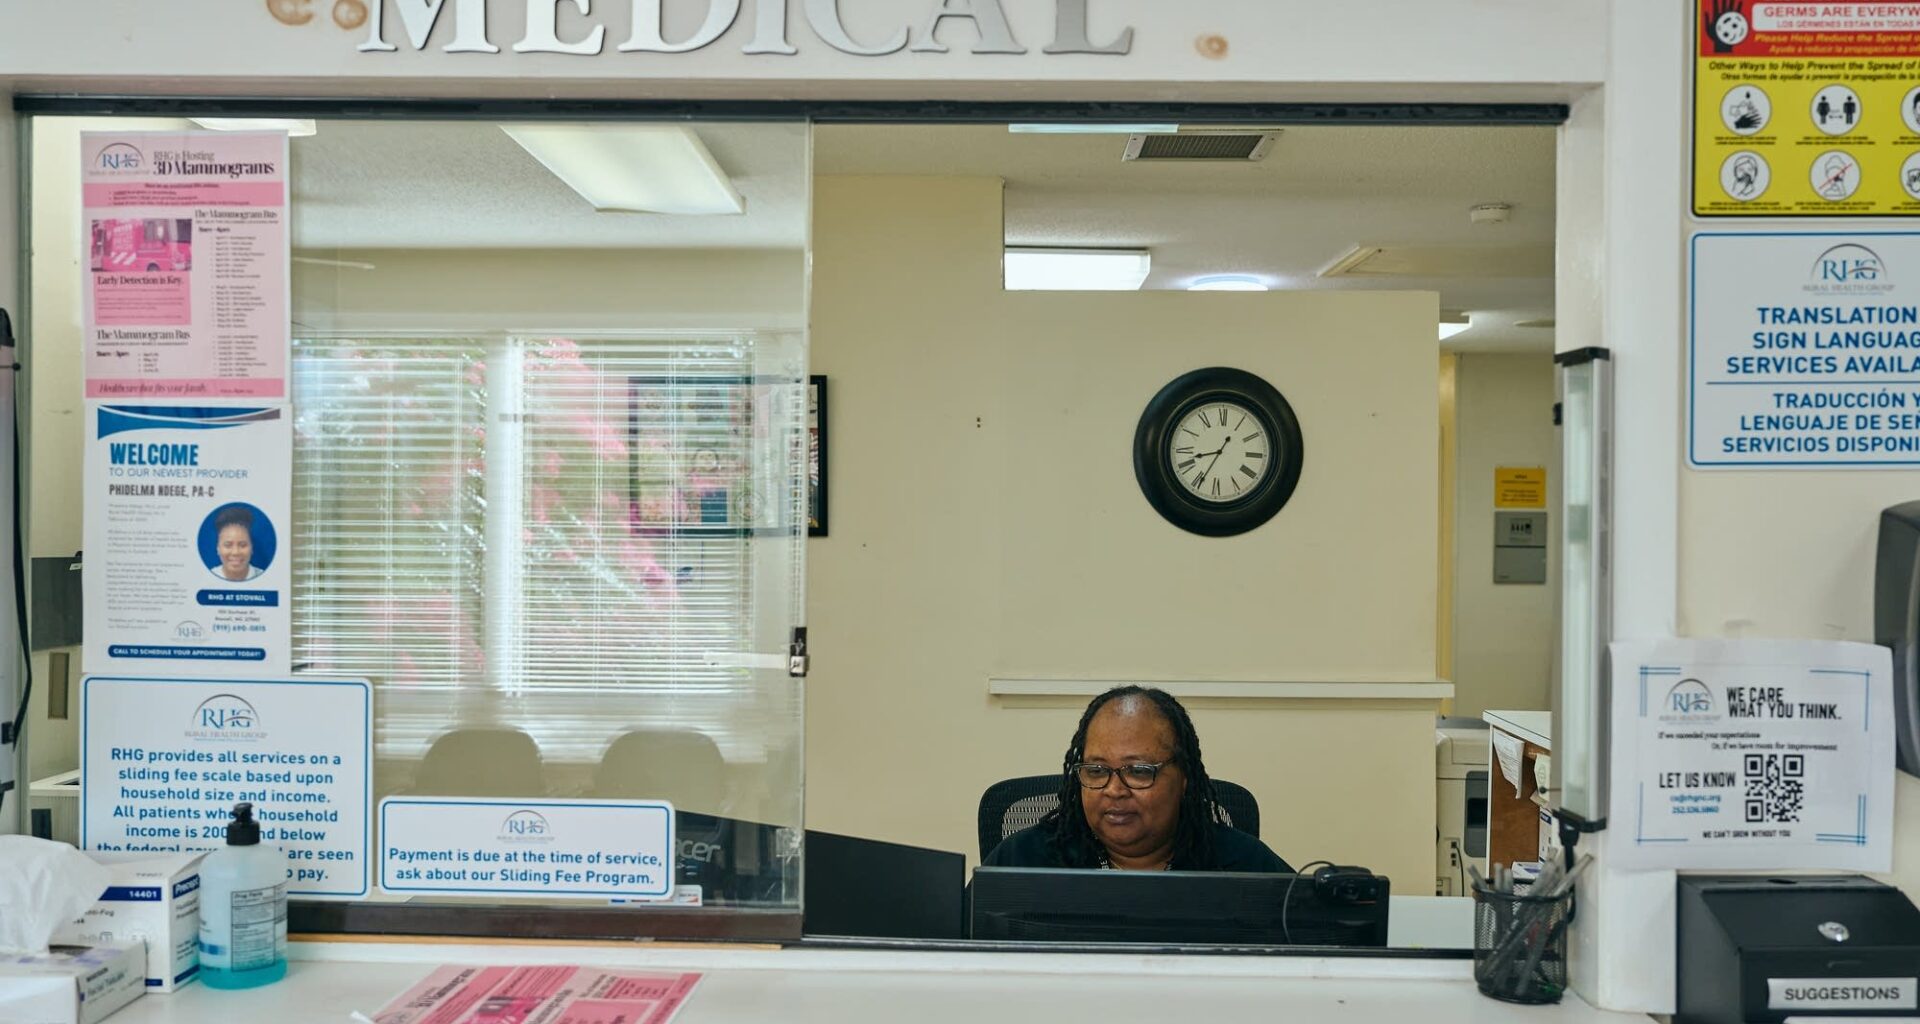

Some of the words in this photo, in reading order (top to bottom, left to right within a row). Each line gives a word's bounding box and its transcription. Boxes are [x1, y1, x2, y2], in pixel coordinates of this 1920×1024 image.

[1764, 6, 1817, 17] GERMS
[1821, 6, 1853, 17] ARE
[1754, 33, 1788, 42] Please
[1790, 33, 1814, 43] Help
[1816, 33, 1854, 42] Reduce
[1856, 33, 1873, 42] the
[1876, 33, 1912, 43] Spread
[1709, 61, 1737, 70] Other
[1739, 61, 1766, 72] Ways
[1769, 61, 1779, 70] to
[1781, 61, 1804, 72] Help
[1807, 61, 1846, 70] Prevent
[1849, 61, 1864, 70] the
[1867, 61, 1902, 72] Spread
[1905, 61, 1917, 70] of
[182, 151, 214, 162] Hosting
[153, 162, 172, 176] 3D
[174, 161, 274, 179] Mammograms
[210, 210, 262, 221] Mammogram
[1823, 258, 1877, 282] RHG
[97, 276, 118, 286] Early
[119, 276, 159, 285] Detection
[1757, 306, 1918, 324] TRANSLATION
[113, 330, 173, 342] Mammogram
[1753, 331, 1806, 349] SIGN
[1726, 356, 1838, 374] SERVICES
[1773, 388, 1905, 409] TRADUCCIÓN
[1740, 414, 1849, 431] LENGUAJE
[1855, 414, 1882, 430] DE
[1722, 437, 1830, 453] SERVICIOS
[110, 443, 199, 466] WELCOME
[109, 467, 123, 478] TO
[127, 467, 150, 478] OUR
[153, 468, 194, 478] NEWEST
[196, 469, 248, 479] PROVIDER
[109, 484, 155, 497] PHIDELMA
[158, 485, 190, 498] NDEGE,
[192, 486, 215, 498] PA-C
[1673, 692, 1709, 713] RHG
[1726, 687, 1747, 702] WE
[1750, 687, 1784, 702] CARE
[202, 708, 251, 729] RHG
[1729, 702, 1763, 718] WHAT
[1768, 703, 1794, 719] YOU
[1798, 704, 1842, 720] THINK.
[111, 747, 144, 761] RHG
[149, 749, 214, 766] provides
[218, 751, 238, 763] all
[242, 752, 306, 765] services
[310, 755, 329, 765] on
[333, 755, 342, 765] a
[118, 768, 170, 784] sliding
[174, 769, 198, 781] fee
[202, 770, 242, 782] scale
[246, 771, 291, 784] based
[296, 774, 334, 788] upon
[1659, 772, 1681, 788] LET
[1684, 772, 1700, 788] US
[1703, 772, 1736, 788] KNOW
[121, 786, 200, 800] household
[204, 789, 234, 801] size
[239, 789, 267, 802] and
[271, 789, 331, 803] income.
[113, 805, 135, 818] All
[139, 806, 201, 821] patients
[259, 809, 338, 822] household
[126, 824, 181, 838] income
[185, 825, 198, 839] is
[259, 828, 275, 840] nd
[280, 829, 326, 841] below
[1703, 831, 1712, 839] WE
[1751, 830, 1777, 838] WITHOUT
[1779, 830, 1791, 838] YOU
[288, 849, 313, 860] are
[317, 850, 354, 861] seen
[389, 848, 453, 864] Payment
[457, 848, 470, 862] is
[473, 850, 501, 862] due
[504, 851, 519, 863] at
[523, 851, 546, 864] the
[550, 851, 583, 864] time
[587, 851, 602, 865] of
[605, 852, 662, 867] service,
[676, 839, 721, 863] cer
[297, 869, 329, 882] pay.
[396, 867, 422, 880] ask
[426, 868, 467, 881] about
[471, 870, 496, 882] our
[500, 869, 551, 885] Sliding
[555, 870, 582, 883] Fee
[586, 871, 655, 887] Program.
[129, 890, 158, 898] 14401
[1784, 986, 1900, 1001] SUGGESTIONS
